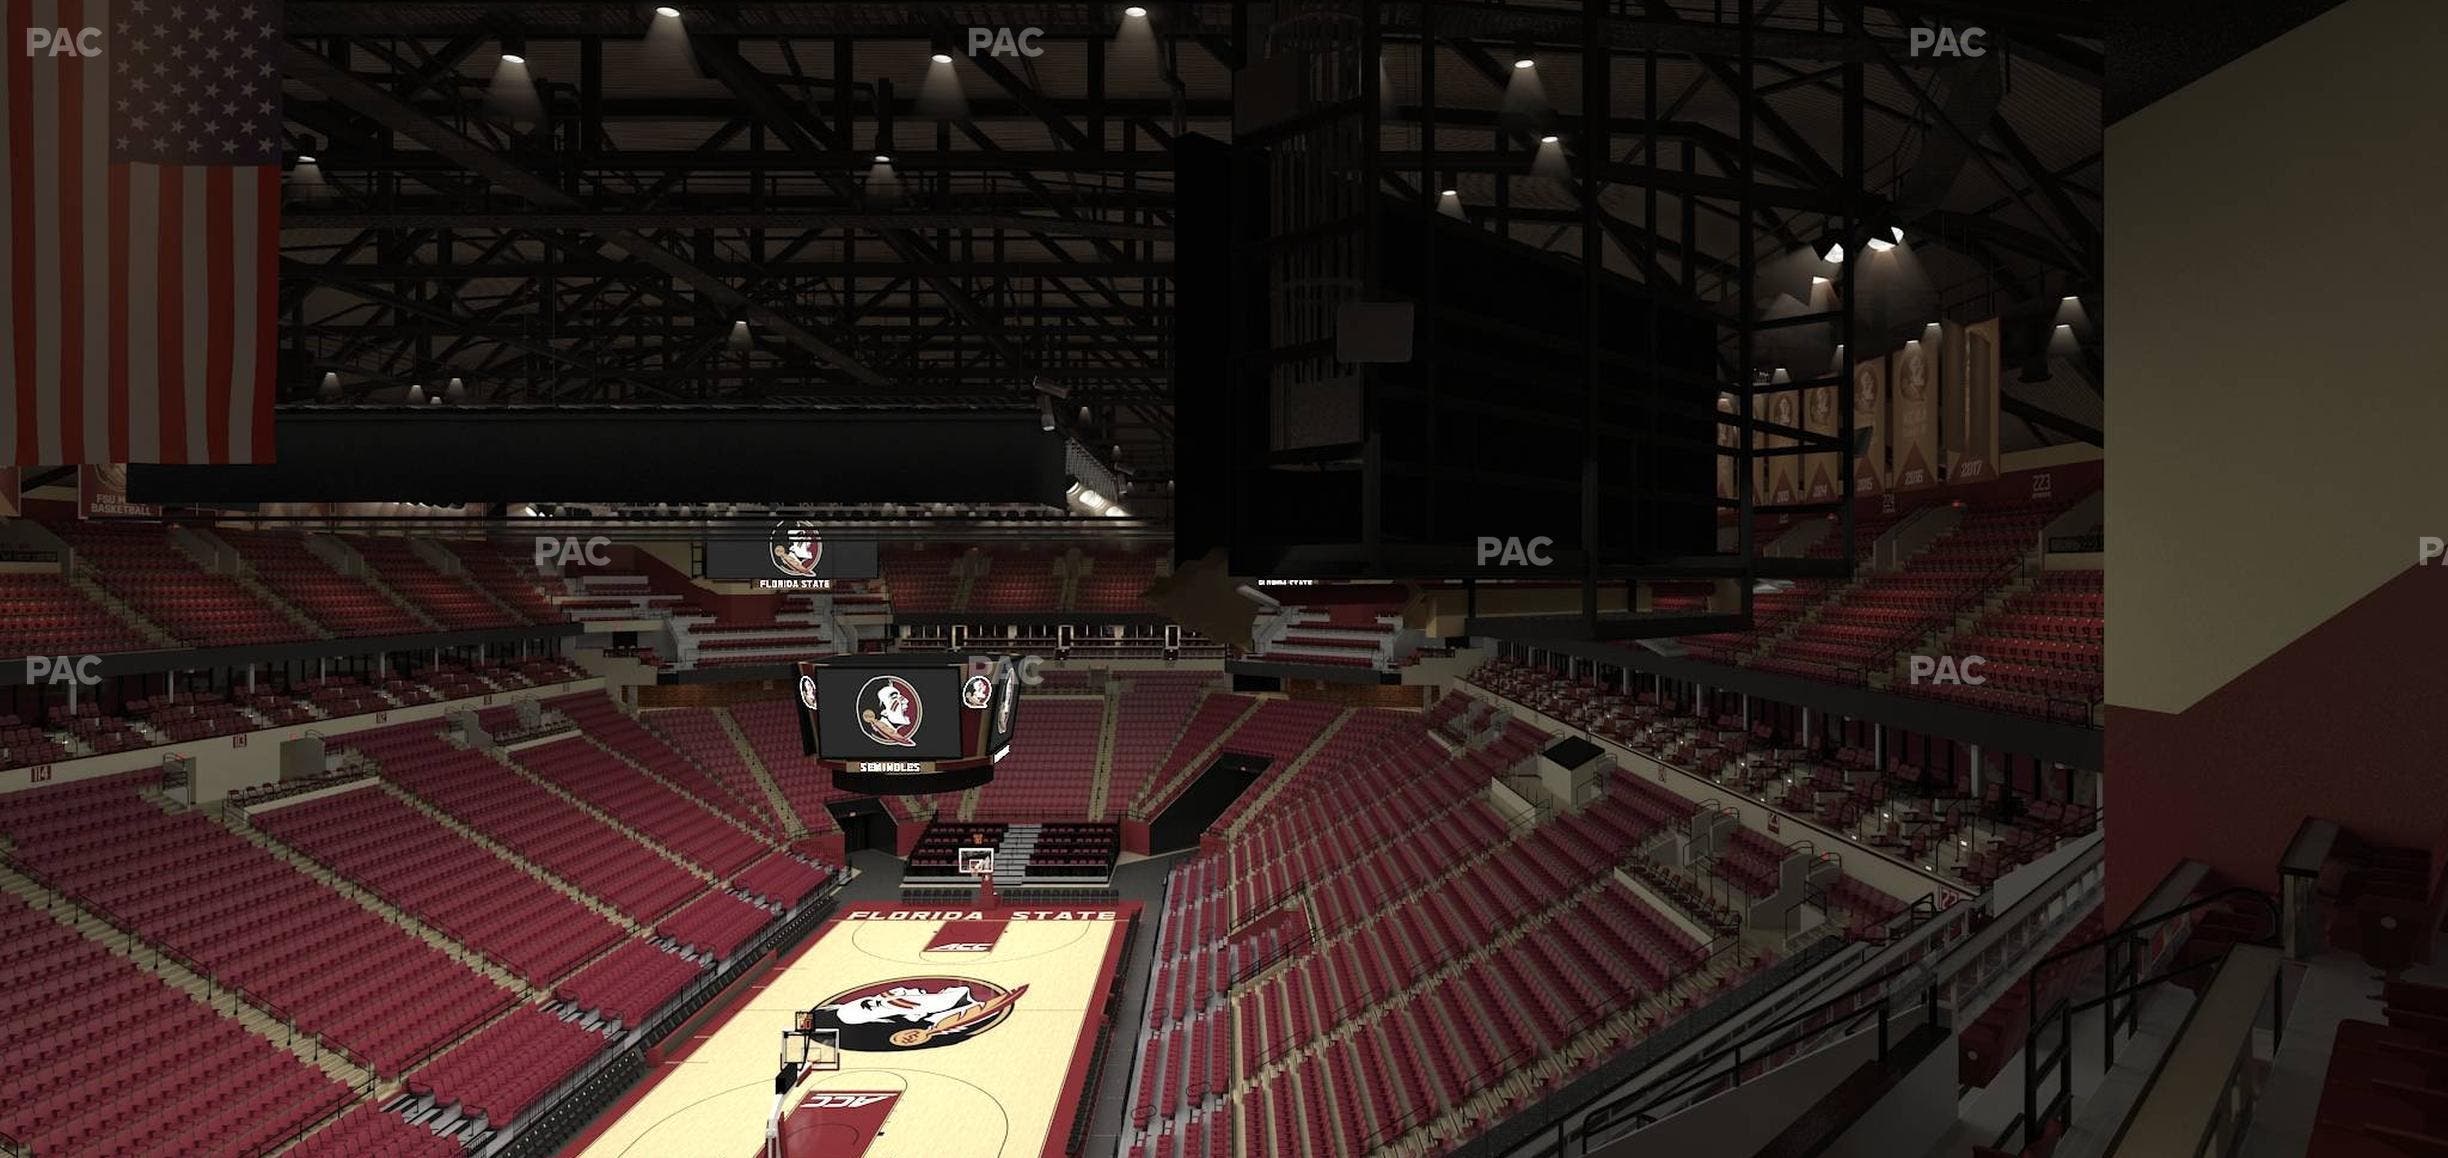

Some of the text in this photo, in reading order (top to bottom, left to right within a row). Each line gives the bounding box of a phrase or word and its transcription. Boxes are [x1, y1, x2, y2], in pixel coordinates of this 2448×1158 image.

[1959, 460, 1983, 478] 2017
[2032, 474, 2051, 492] 223
[90, 503, 152, 515] BASKETBALL
[760, 579, 830, 588] FLORIDA STATE
[860, 762, 921, 774] SEMINOLES
[848, 911, 1116, 921] FLORIDA STATE
[927, 942, 994, 952] ACC
[799, 1093, 899, 1109] ACC
